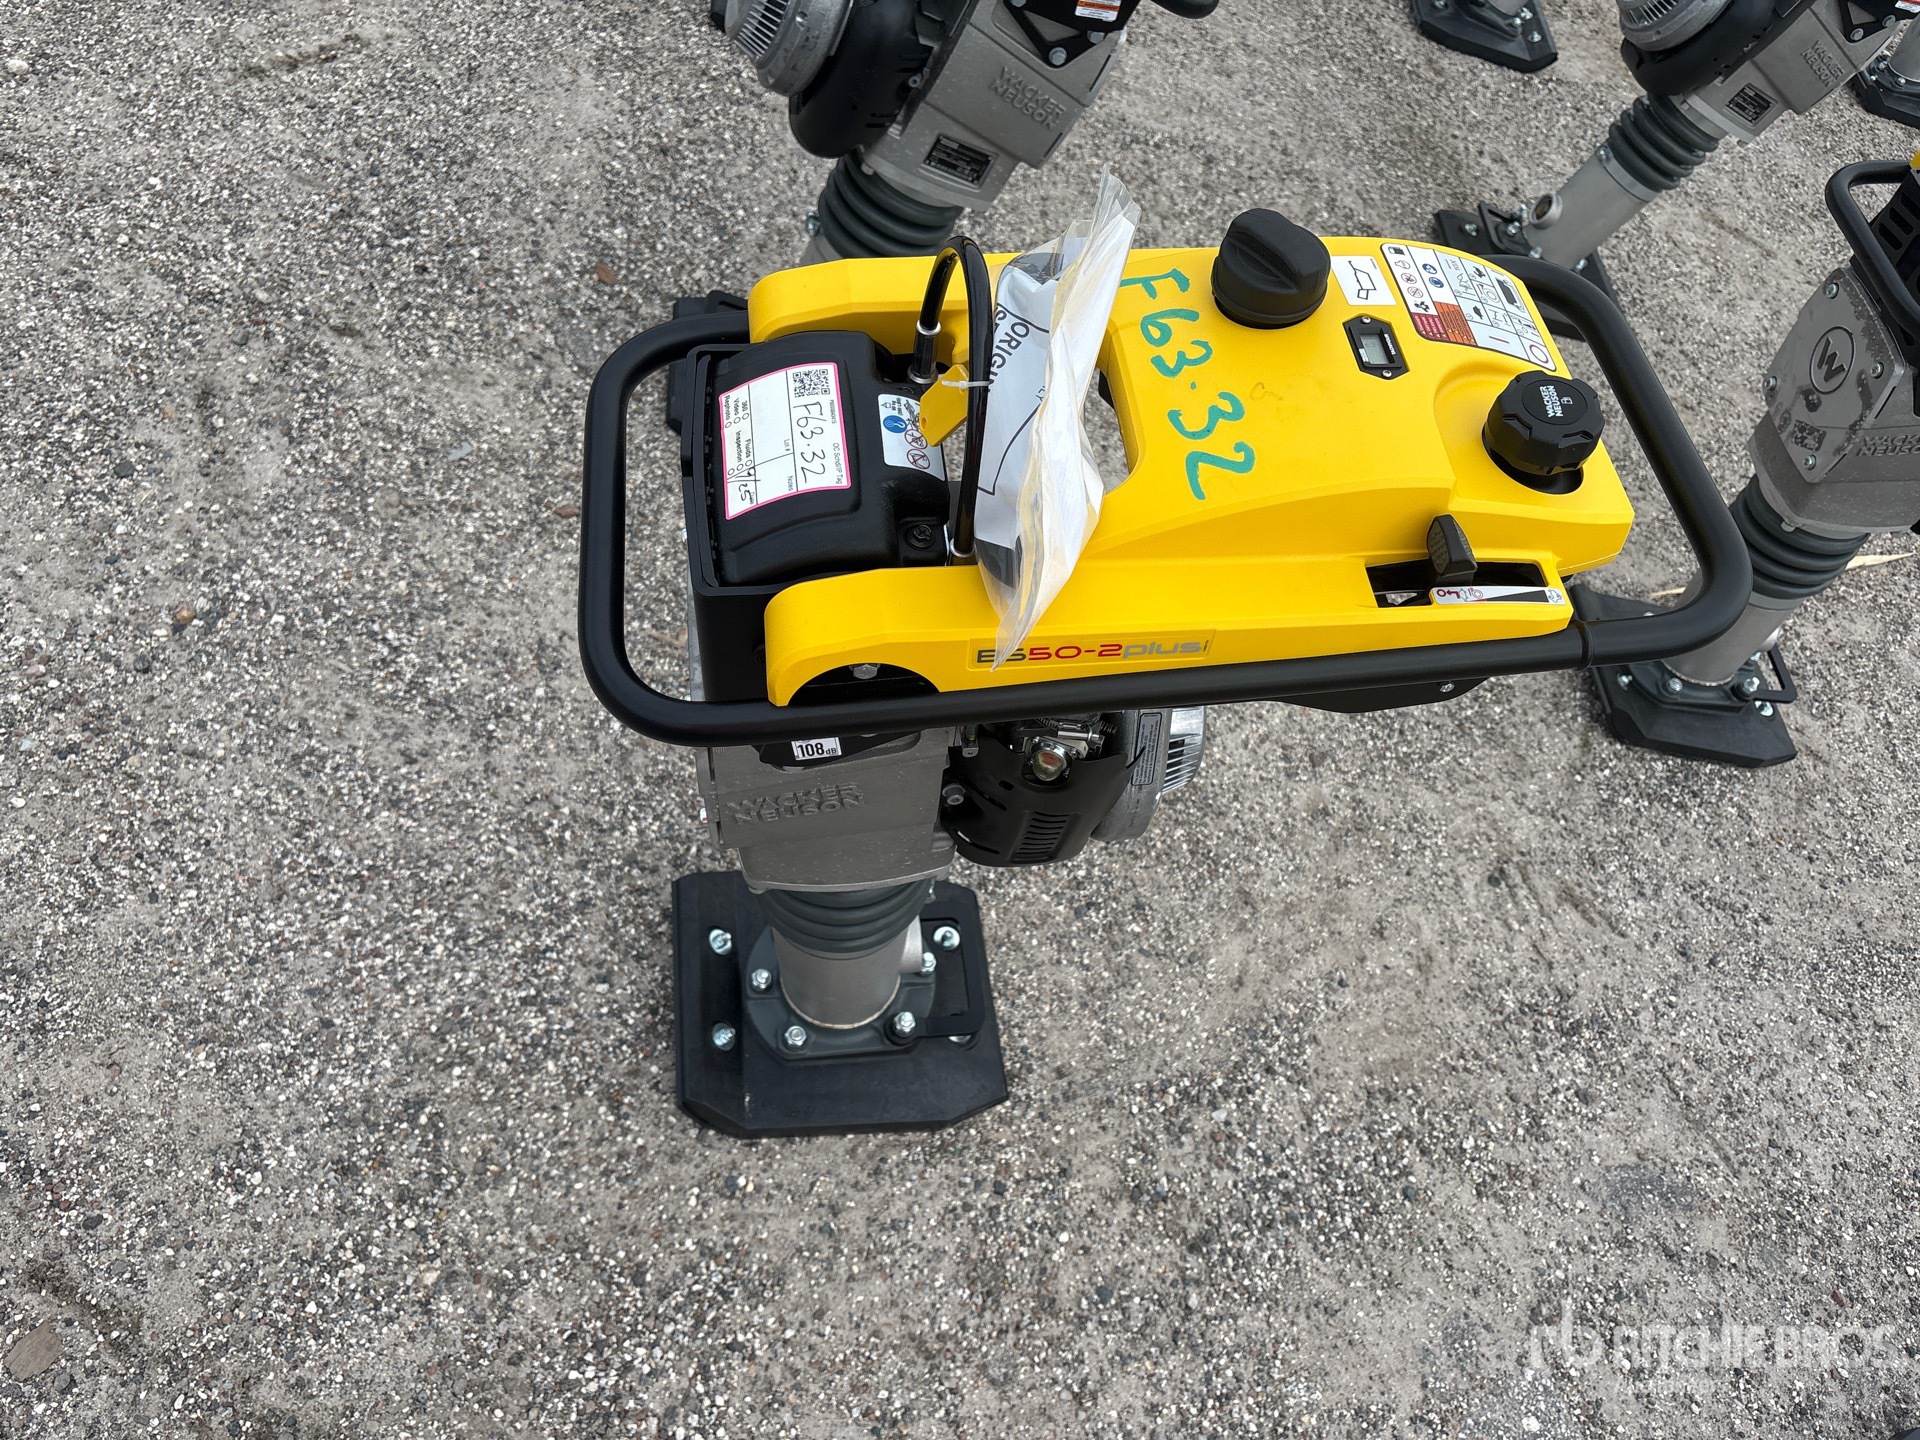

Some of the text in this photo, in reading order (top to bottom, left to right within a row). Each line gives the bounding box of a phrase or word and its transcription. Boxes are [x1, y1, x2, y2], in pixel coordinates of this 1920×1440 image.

[1000, 66, 1067, 119] WACKER
[733, 398, 741, 416] Video
[1540, 386, 1555, 417] WACKER
[1547, 385, 1563, 417] NEUSON
[735, 430, 743, 463] Inspection
[744, 438, 752, 459] Fluids
[797, 742, 837, 758] 108 dB
[727, 782, 864, 812] WACKER
[733, 798, 865, 826] NEUSON
